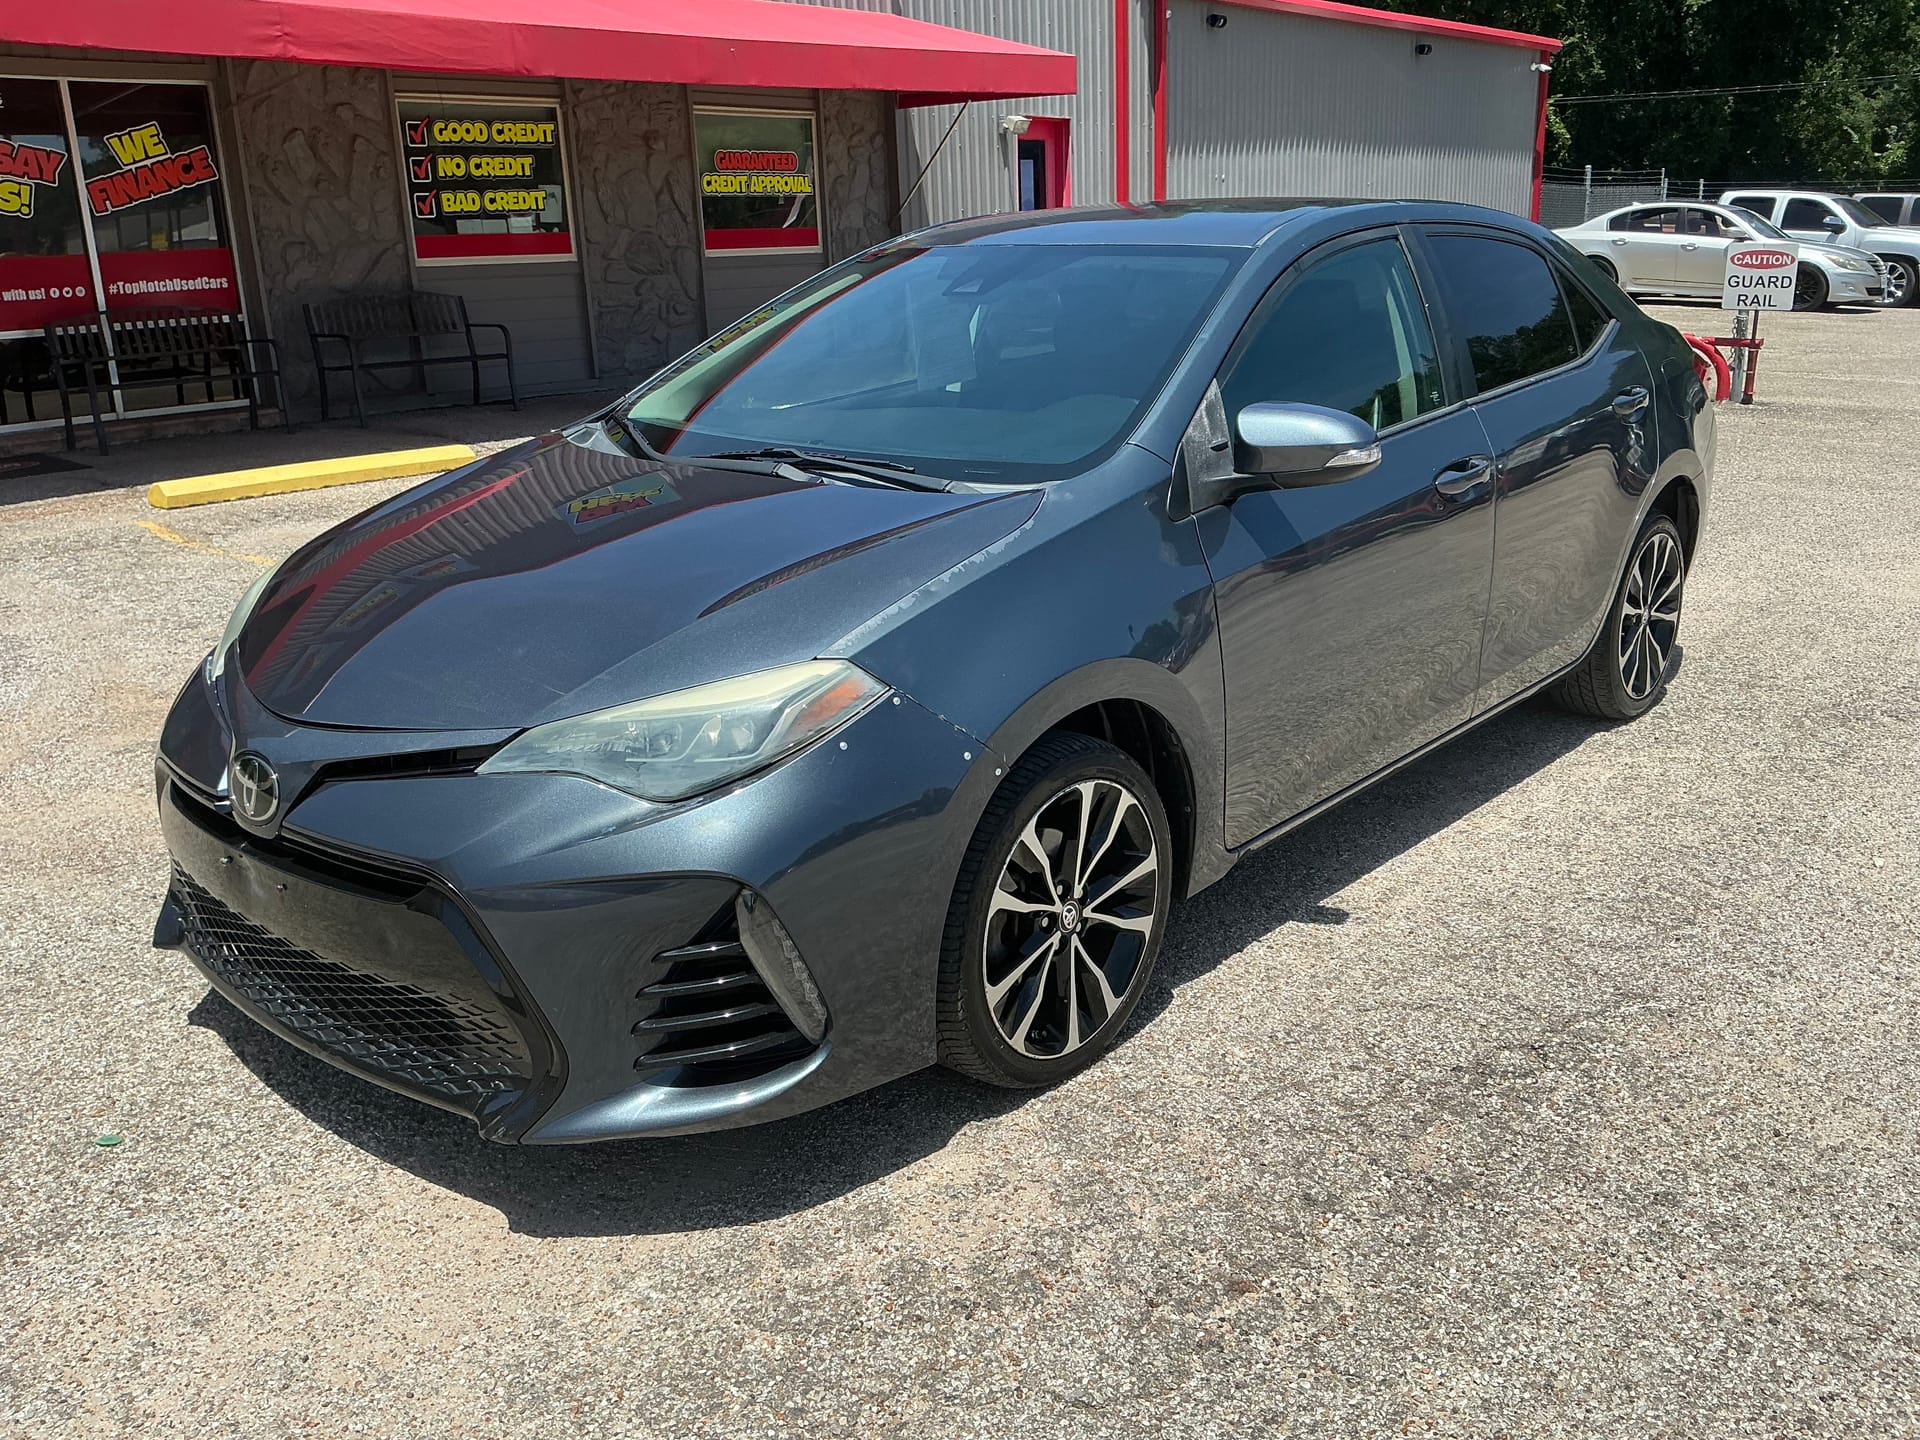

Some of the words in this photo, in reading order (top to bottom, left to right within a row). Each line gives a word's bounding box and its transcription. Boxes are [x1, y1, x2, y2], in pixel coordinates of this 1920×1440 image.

[432, 121, 489, 143] GOOD
[491, 122, 555, 144] CREDIT
[107, 124, 167, 166] WE
[437, 156, 467, 177] NO
[469, 156, 534, 177] CREDIT
[715, 151, 797, 172] GUARANTEED
[86, 147, 216, 214] FINANCE
[702, 175, 749, 193] CREDIT
[750, 175, 813, 194] APPROVAL
[440, 191, 481, 213] BAD
[483, 190, 547, 212] CREDIT
[1733, 254, 1792, 265] CAUTION
[108, 276, 229, 295] #TopNotchUsedCars
[1727, 274, 1793, 289] GUARD
[2, 288, 27, 302] with
[28, 287, 46, 300] us!
[1736, 293, 1778, 308] RAIL
